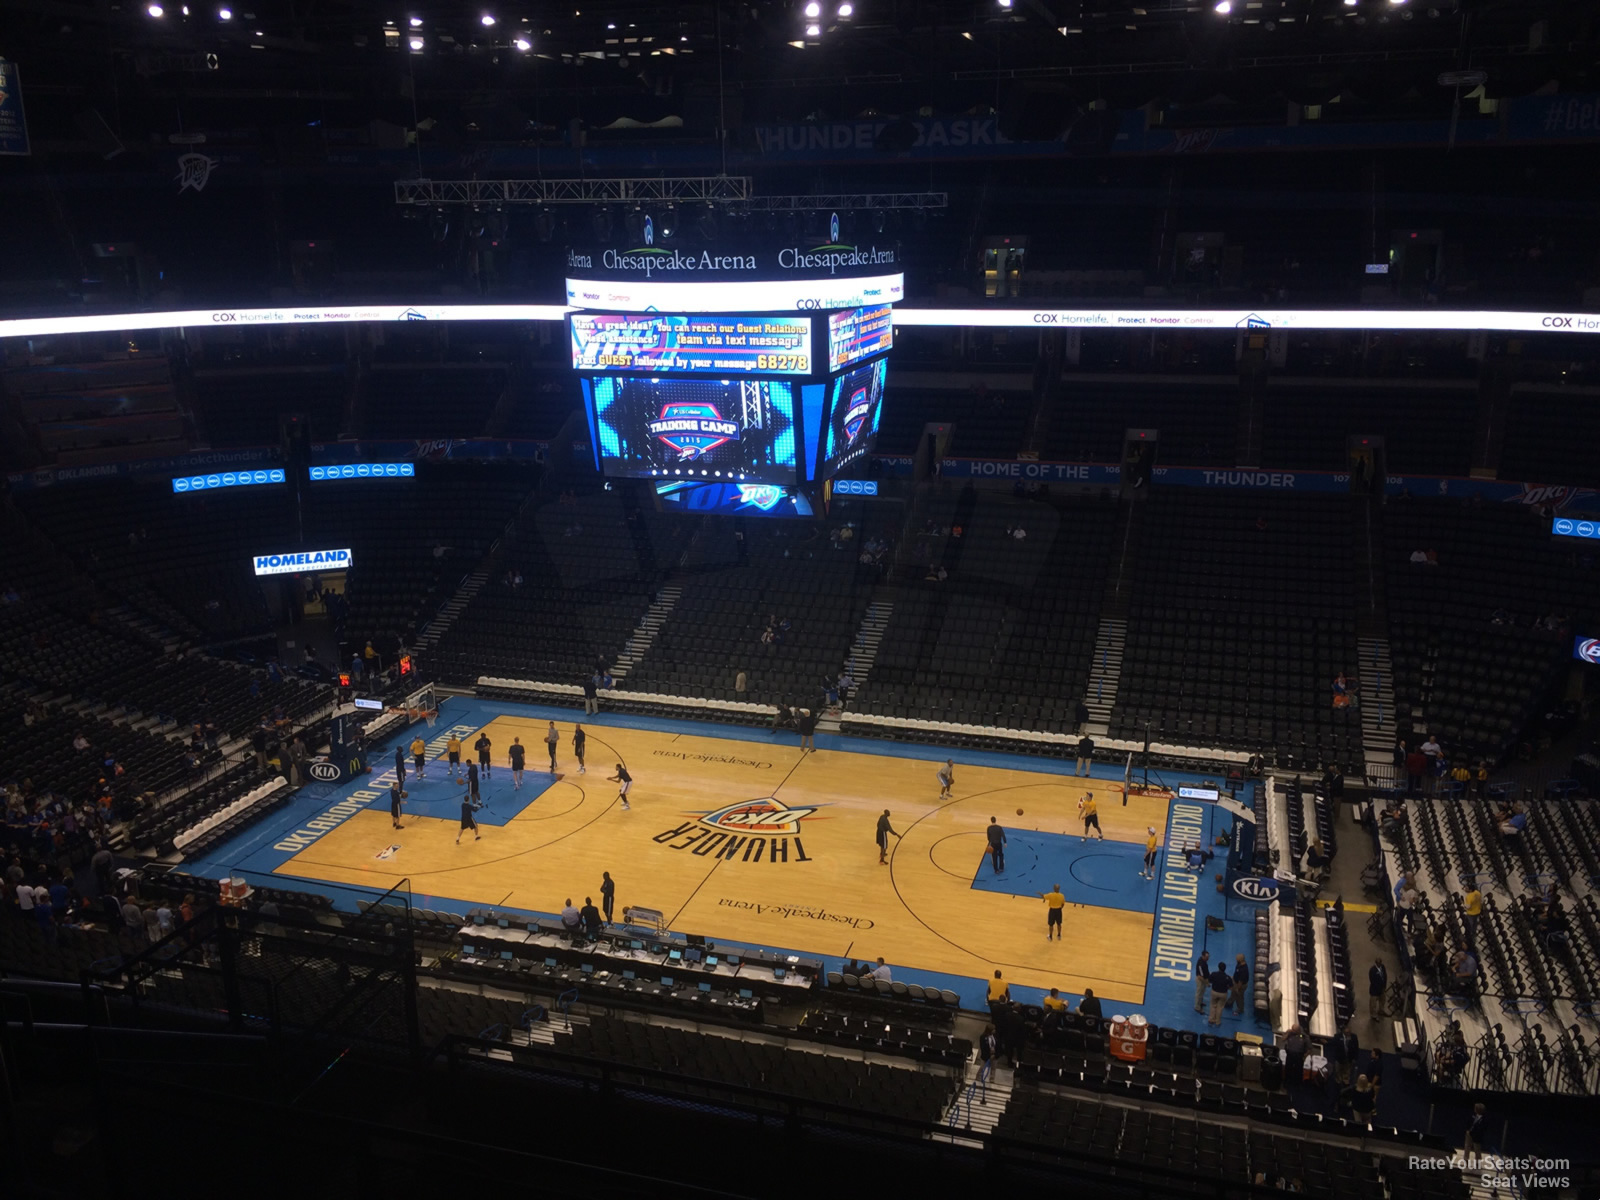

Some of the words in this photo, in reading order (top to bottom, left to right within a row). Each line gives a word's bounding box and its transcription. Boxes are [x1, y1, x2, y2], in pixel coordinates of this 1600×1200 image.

[756, 124, 886, 151] HUNDE
[603, 249, 696, 277] Chesapeake
[698, 250, 757, 270] Arena
[778, 247, 868, 274] Chesapeake
[869, 248, 895, 265] Arena
[796, 298, 821, 310] COX
[212, 313, 237, 322] COX
[1033, 313, 1058, 324] COX
[1542, 316, 1573, 328] COX
[674, 324, 689, 332] can
[691, 323, 717, 333] reach
[719, 325, 735, 333] our
[737, 323, 762, 333] Guest
[764, 324, 808, 335] Relations
[677, 335, 704, 345] team
[706, 334, 723, 345] via
[725, 335, 747, 345] text
[598, 354, 633, 366] GUEST
[634, 355, 674, 367] followed
[676, 356, 689, 370] by
[691, 360, 713, 370] your
[757, 354, 808, 371] 68278
[650, 420, 698, 433] TRAINING
[700, 420, 736, 435] CAMP
[680, 436, 701, 444] 2015
[970, 462, 1019, 477] HOME
[1025, 463, 1050, 478] OF
[1055, 465, 1090, 480] THE
[1203, 471, 1296, 488] THUNDER
[256, 551, 348, 569] HOMELAND
[652, 749, 693, 760] Arena
[692, 753, 773, 770] Chesapeake
[314, 766, 336, 778] KIA
[273, 789, 383, 853] OKLAHOMA
[721, 807, 819, 825] OKC
[652, 821, 813, 863] THUNDER
[1162, 871, 1198, 905] CITY
[718, 898, 770, 914] Arena
[770, 906, 875, 930] Chesapeake
[1153, 906, 1196, 982] THUNDER
[1121, 1042, 1135, 1055] G
